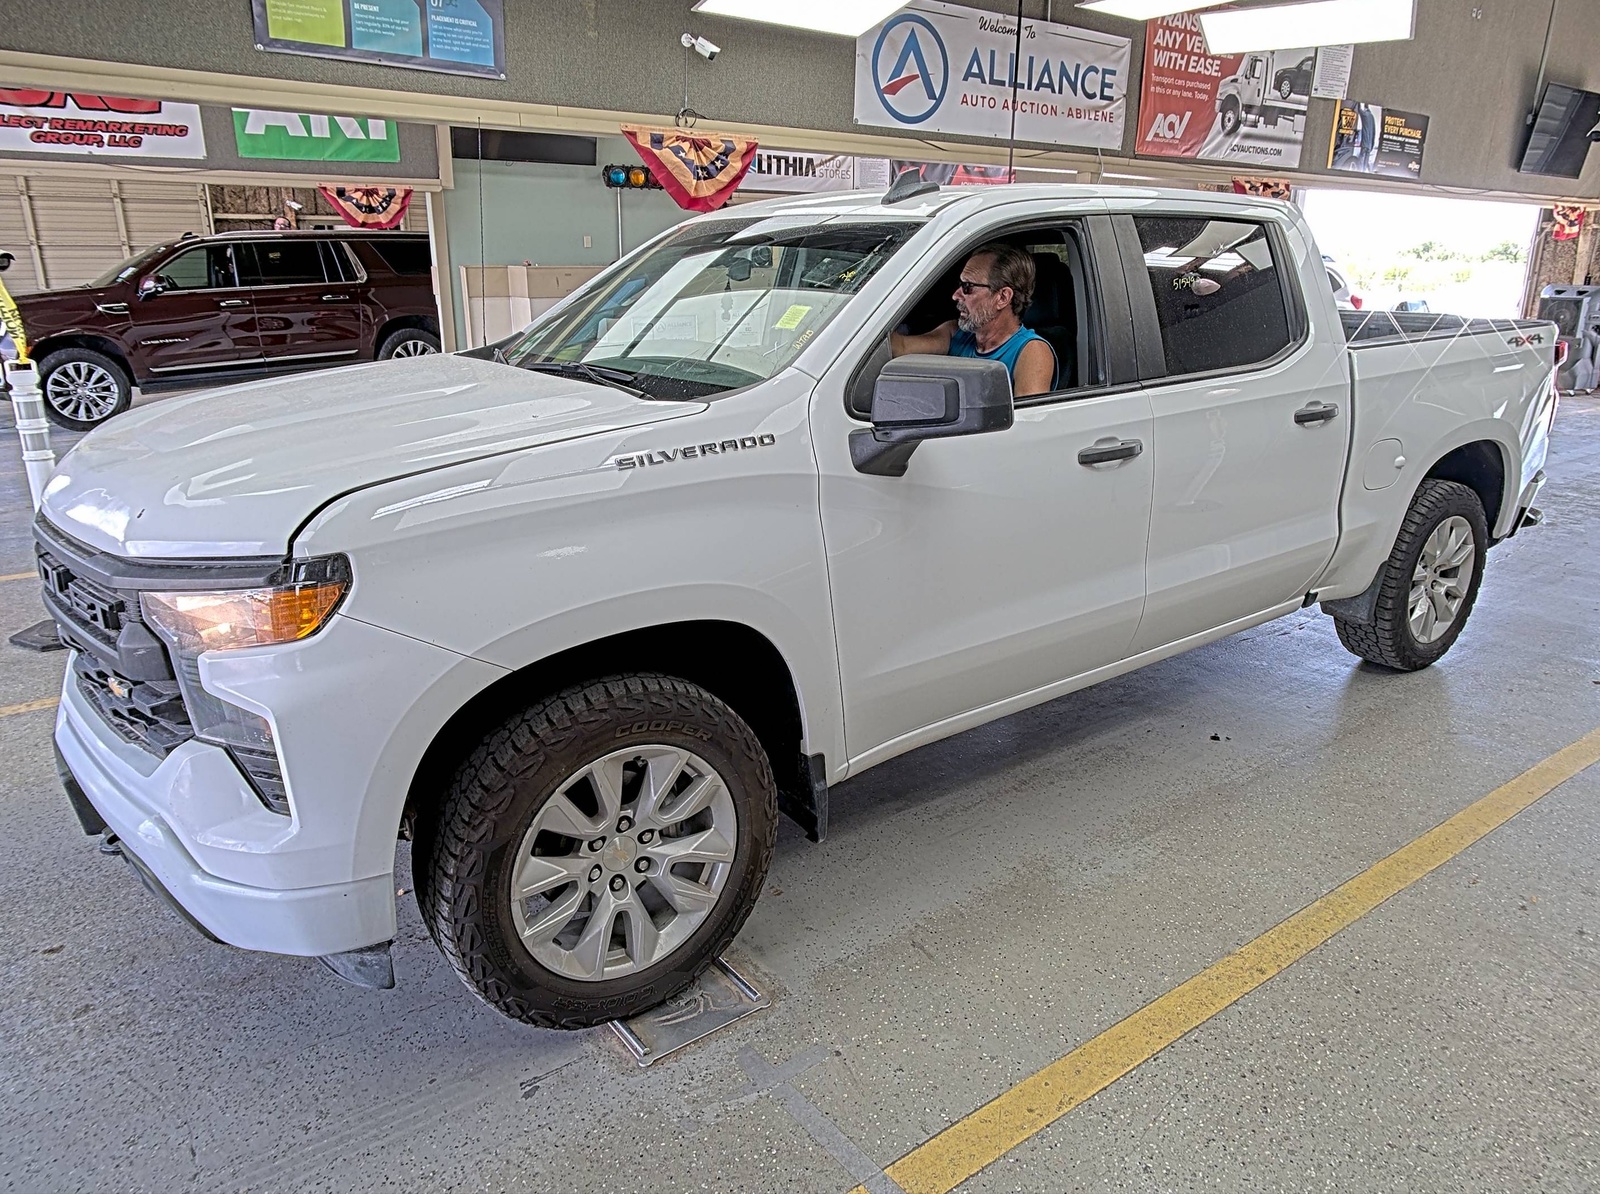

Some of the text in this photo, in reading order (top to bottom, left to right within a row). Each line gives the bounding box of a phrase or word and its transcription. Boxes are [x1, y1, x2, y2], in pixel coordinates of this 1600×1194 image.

[360, 4, 379, 12] PRESENT
[431, 14, 454, 23] PLACEMENT
[459, 19, 477, 27] CRITICAL
[1024, 25, 1036, 39] To
[1153, 29, 1184, 49] ANY
[1153, 49, 1222, 77] WITH EASE.
[962, 47, 1117, 102] ALLIANCE
[1151, 73, 1211, 91] Transport cars purchased
[1150, 85, 1155, 93] in
[1156, 86, 1165, 94] this
[1171, 89, 1181, 98] any
[1181, 90, 1194, 98] lane.
[1194, 92, 1209, 102] Today.
[960, 93, 996, 109] AUTO
[1002, 101, 1058, 117] AUCTION
[1067, 107, 1114, 123] ABILENE
[49, 117, 188, 137] REMARKETING
[1146, 111, 1192, 142] ACV
[1384, 125, 1399, 135] EVERY
[1385, 116, 1406, 127] PROTECT
[31, 131, 143, 148] GROUP, LLC
[757, 154, 818, 178] LITHIA
[819, 168, 851, 180] STORES
[141, 337, 190, 345] DENALI
[614, 433, 776, 471] SILVERADO
[615, 720, 713, 742] COOPER
